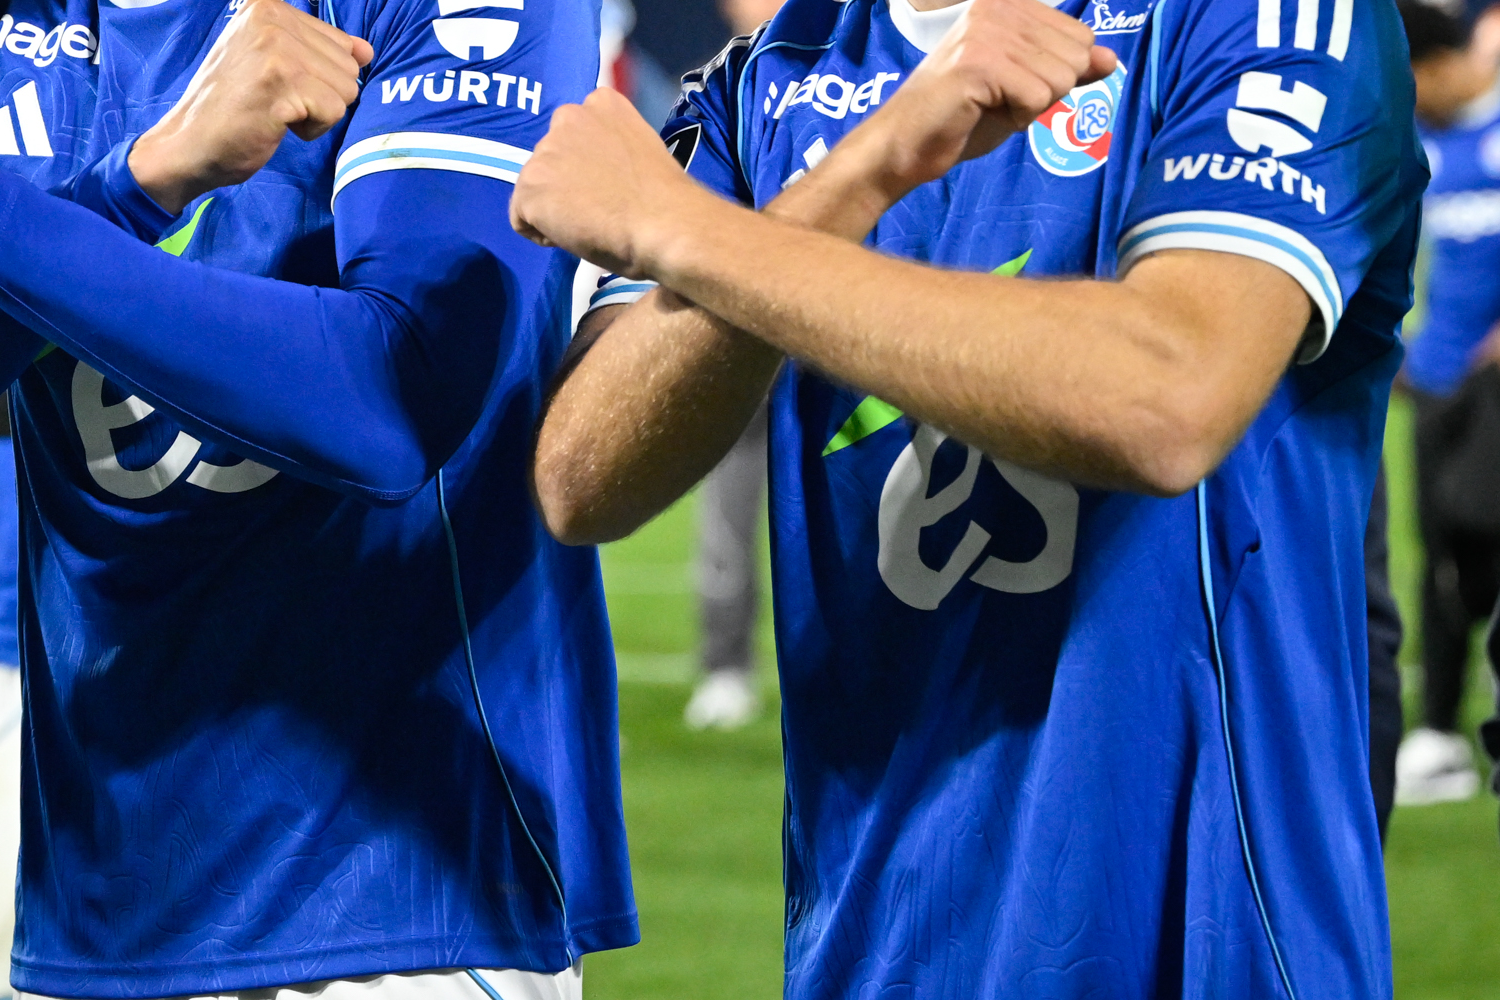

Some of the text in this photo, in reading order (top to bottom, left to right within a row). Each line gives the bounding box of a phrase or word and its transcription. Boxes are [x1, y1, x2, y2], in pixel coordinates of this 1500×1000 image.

[381, 70, 542, 115] WÜRTH
[1163, 153, 1326, 215] WÜRTH
[71, 359, 281, 499] e
